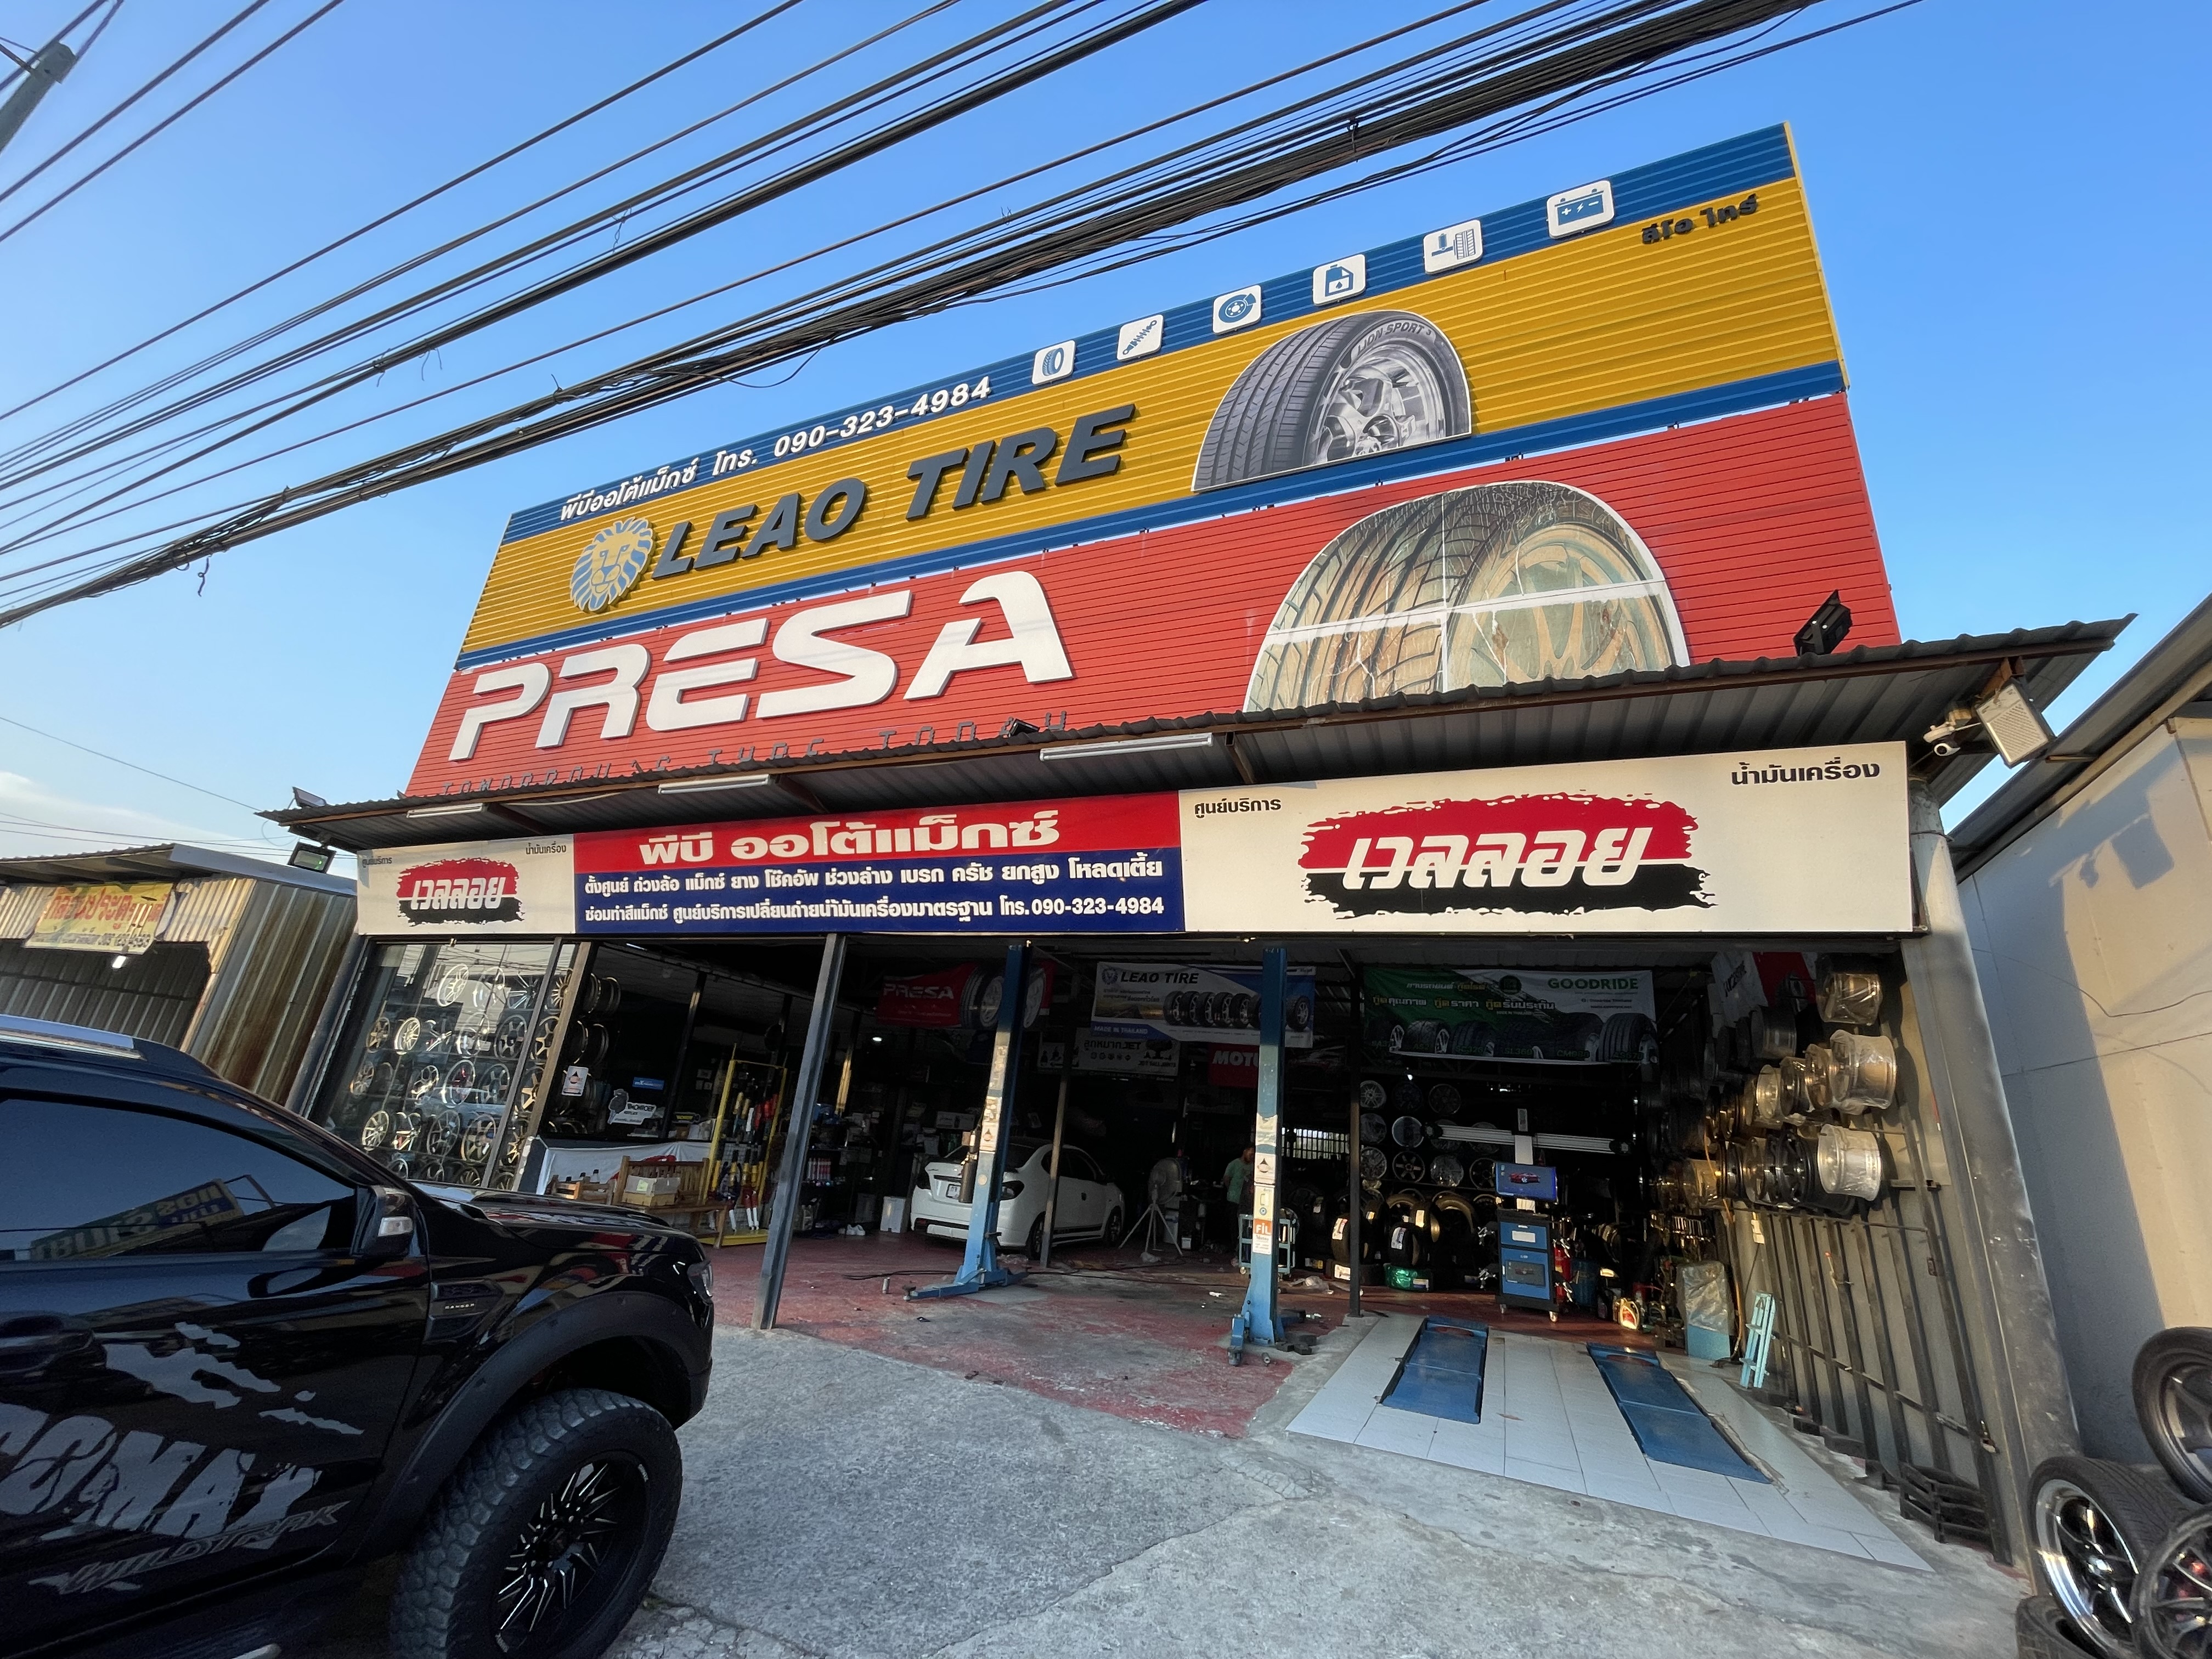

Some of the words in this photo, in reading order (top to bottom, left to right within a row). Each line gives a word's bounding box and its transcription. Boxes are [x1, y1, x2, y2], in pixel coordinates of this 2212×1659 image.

[1357, 328, 1383, 354] LION
[1385, 321, 1424, 335] SPORT
[712, 449, 758, 476] โทร.
[774, 376, 991, 458] 090-323-4984
[652, 478, 869, 580] LEAO
[906, 404, 1136, 521] TIRE
[448, 571, 1074, 763] PRESA
[1730, 757, 1880, 786] น้ำมันเครื่อง
[1194, 797, 1282, 819] ศูนย์บริการ
[526, 841, 567, 855] น้ำมันเครื่อง
[639, 831, 714, 865] พีบี
[731, 810, 1060, 860] ออโต้แม็กซ์
[585, 875, 629, 898] ตั้งศูนย์
[634, 874, 680, 893] ถ่วงล้อ
[686, 872, 725, 891] แม็กซ์
[731, 875, 759, 889] ยาง
[825, 866, 893, 886] ช่วงล่าง
[900, 867, 944, 883] เบรก
[952, 862, 994, 882] ครัช
[1002, 864, 1059, 884] ยกสูง
[1068, 851, 1163, 879] โหลดเตี้ย
[1342, 826, 1654, 890] เวลลอย
[410, 877, 506, 910] เวลลอย
[585, 903, 668, 921] ซ่อมทำสีแม็กซ์
[673, 895, 993, 924] ศูนย์บริการเปลี่ยนถ่ายน้ำมันเครื่องมาตรฐาน
[883, 983, 954, 1000] PRESA
[1121, 972, 1159, 983] LEAO
[1165, 973, 1200, 984] TIRE
[1548, 978, 1638, 990] GOODRIDE
